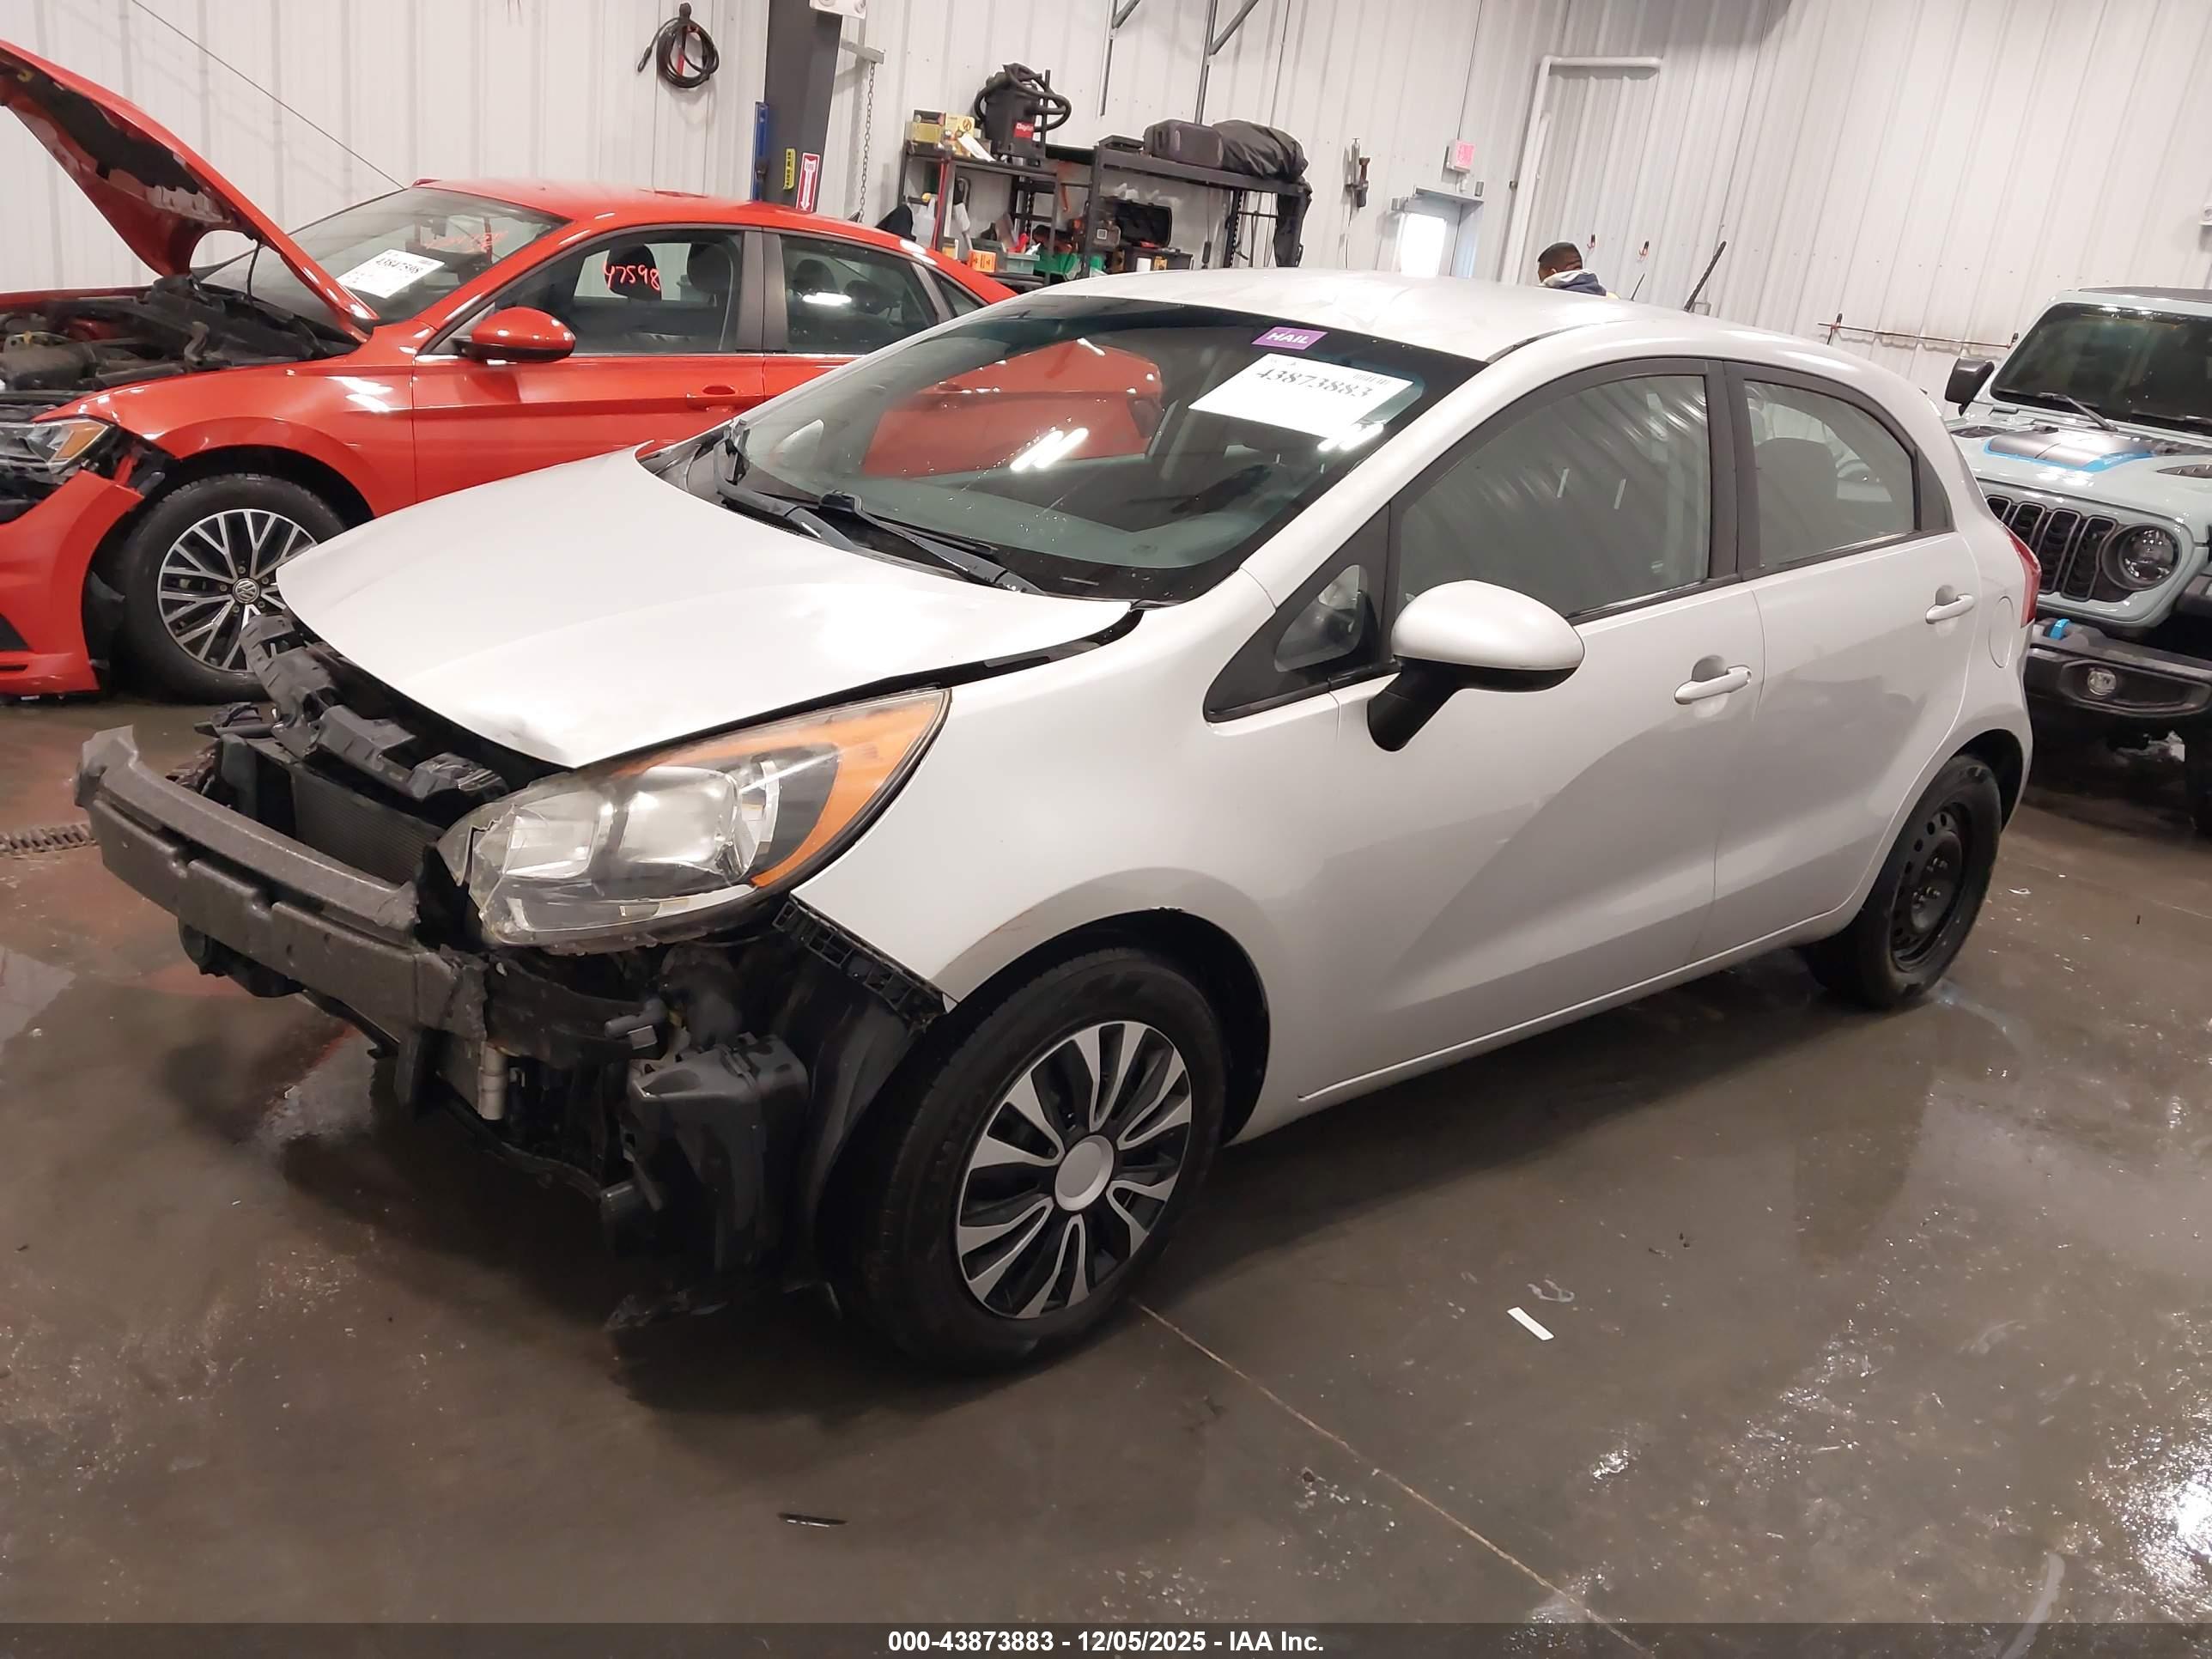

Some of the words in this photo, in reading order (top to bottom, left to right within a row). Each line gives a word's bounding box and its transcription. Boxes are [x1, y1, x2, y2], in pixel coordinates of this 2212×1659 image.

[603, 261, 660, 291] 47598
[1266, 332, 1310, 344] HAIL
[1256, 368, 1373, 397] 43873883
